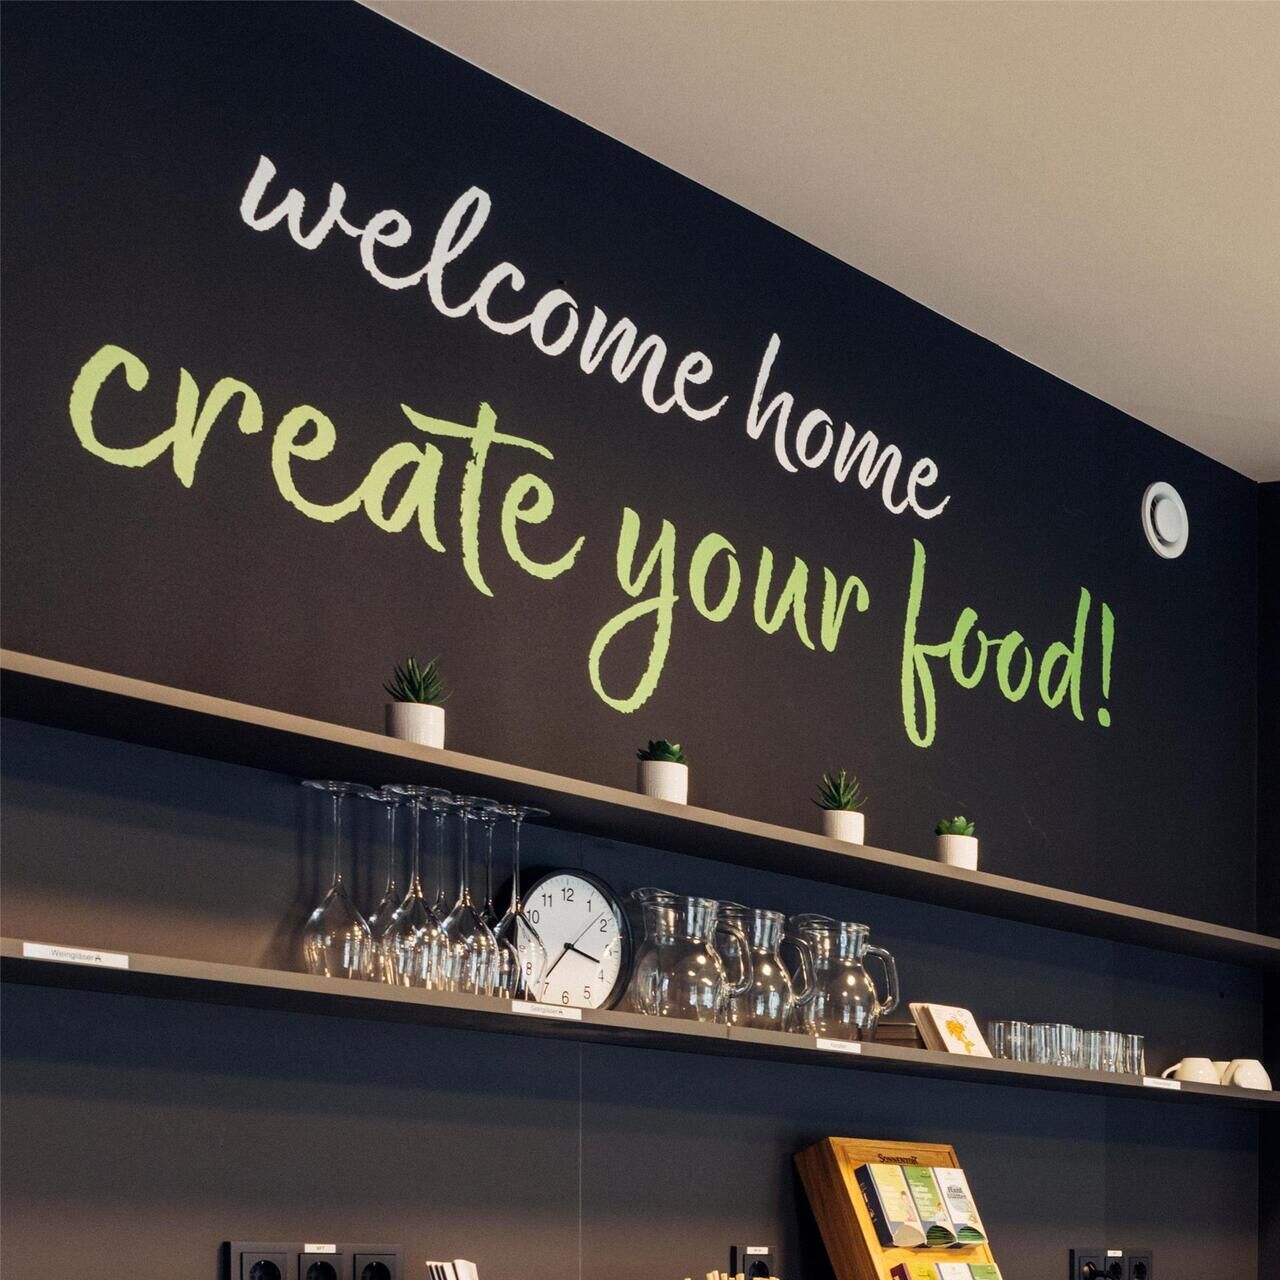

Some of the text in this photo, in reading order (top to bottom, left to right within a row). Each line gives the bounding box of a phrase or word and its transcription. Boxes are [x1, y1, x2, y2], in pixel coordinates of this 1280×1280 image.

[240, 154, 951, 519] welcome home
[69, 343, 1114, 748] create your food!
[541, 894, 553, 908] 11
[561, 888, 575, 902] 12
[586, 900, 592, 913] 1
[526, 910, 540, 924] 10
[599, 919, 608, 933] 2
[598, 970, 604, 982] 4
[543, 982, 550, 995] 7
[583, 986, 591, 1000] 5
[561, 990, 570, 1005] 6
